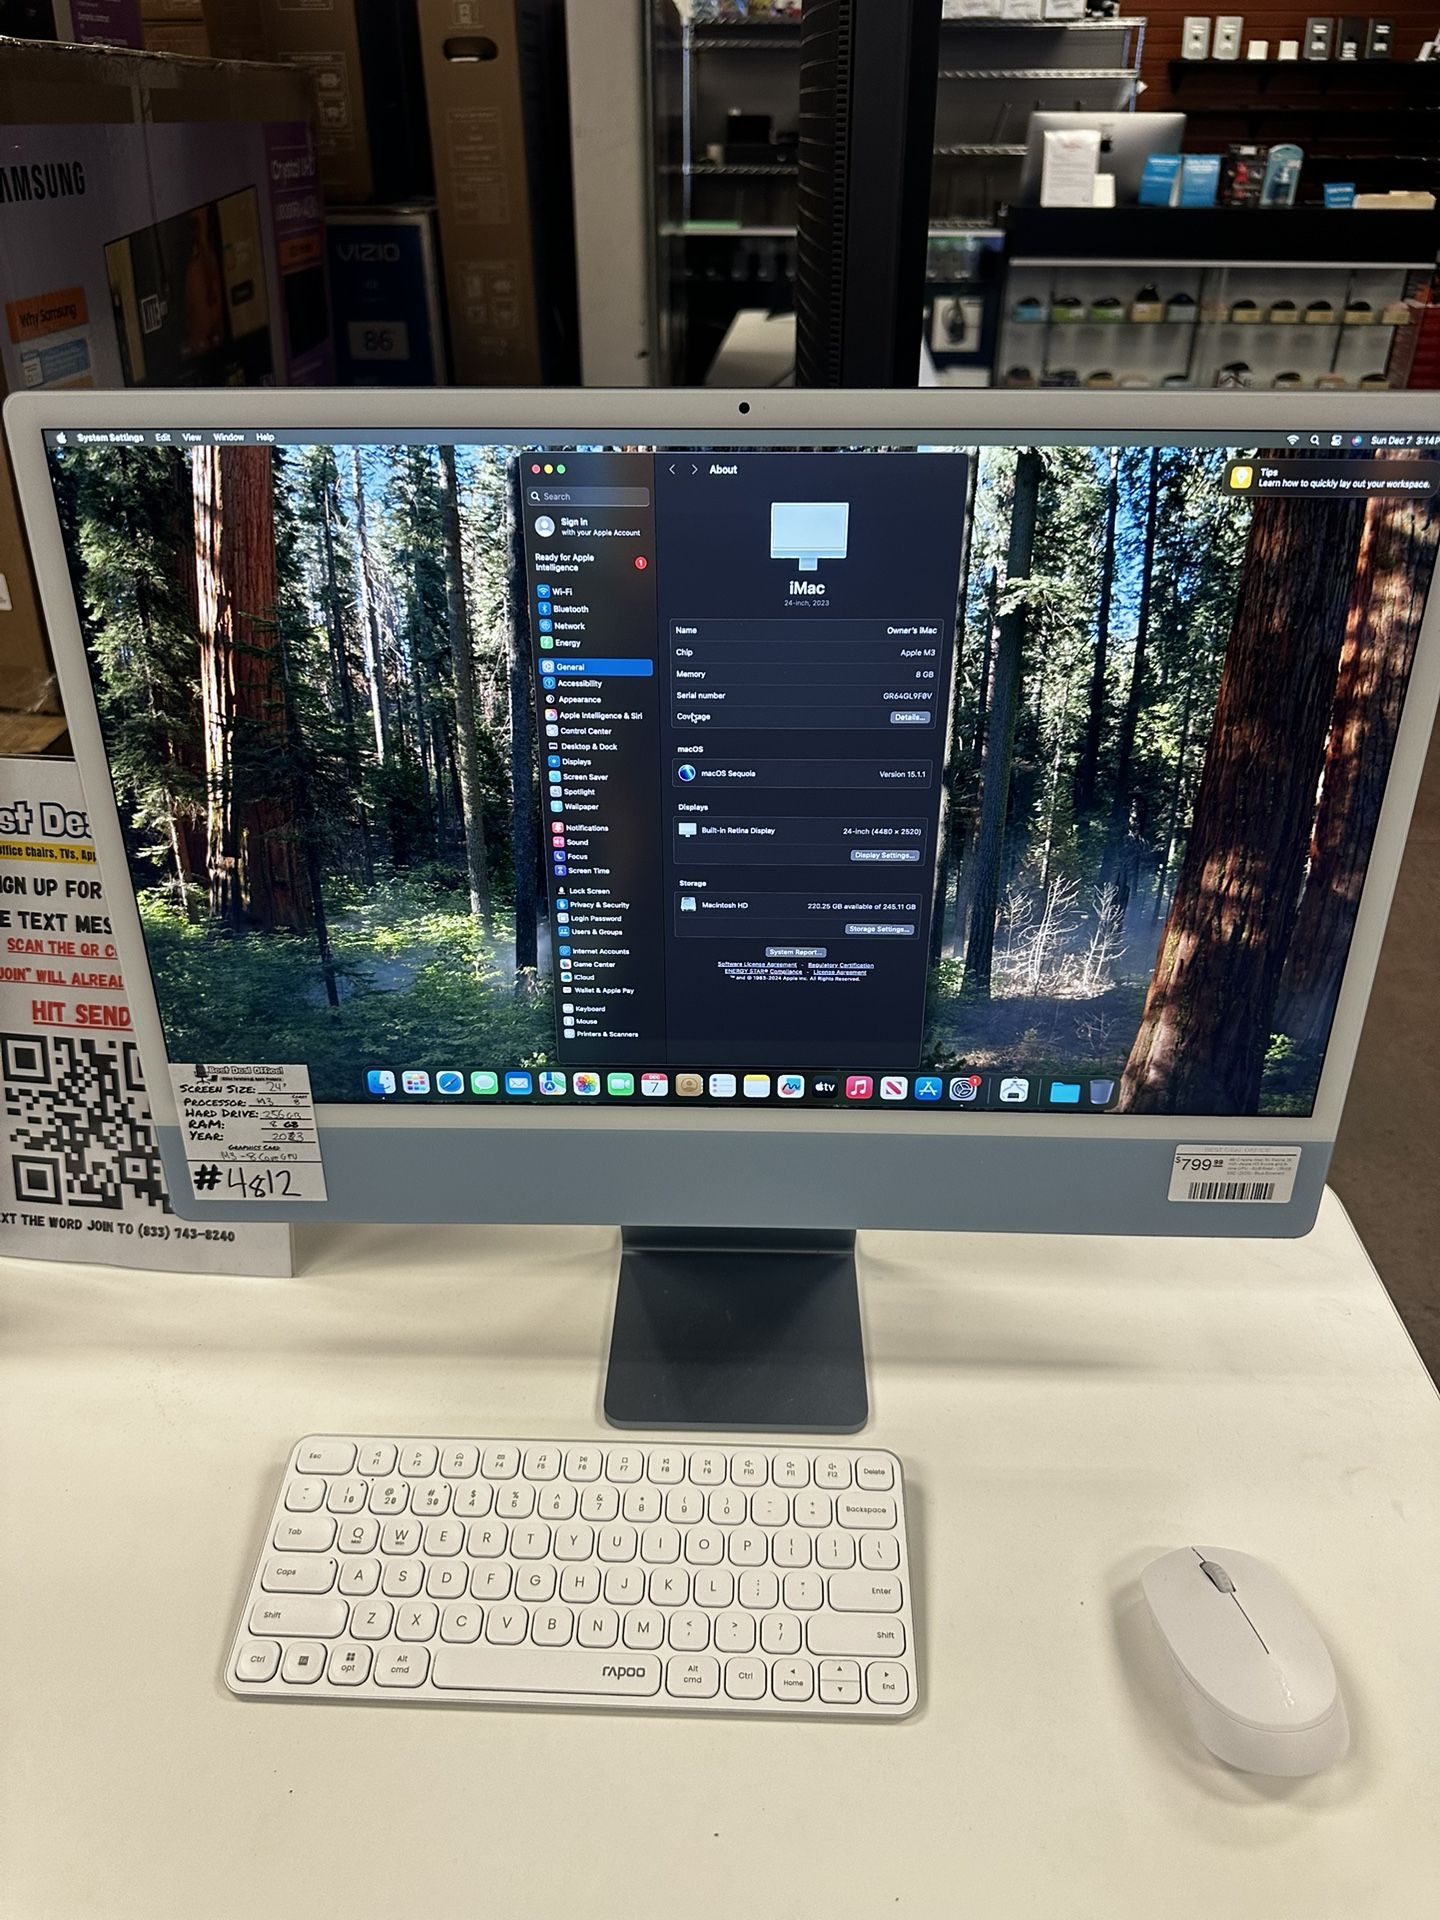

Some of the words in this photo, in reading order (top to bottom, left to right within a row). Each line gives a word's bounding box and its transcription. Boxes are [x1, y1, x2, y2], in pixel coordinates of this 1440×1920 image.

[337, 243, 400, 262] VIZIO
[19, 312, 39, 328] Why
[40, 303, 77, 322] Samsung
[364, 331, 394, 352] 86
[77, 433, 108, 443] System
[109, 433, 144, 443] Settings
[155, 433, 171, 442] Edit
[182, 433, 201, 441] View
[213, 433, 244, 441] Window
[256, 433, 275, 442] Help
[1371, 436, 1387, 445] Sun
[1388, 436, 1405, 445] Dec
[1406, 436, 1413, 444] 7
[709, 464, 737, 474] About
[1261, 468, 1278, 478] Tips
[1259, 479, 1281, 487] Learn
[1282, 479, 1299, 487] how
[1310, 479, 1338, 489] quickly
[1367, 481, 1385, 489] your
[1386, 479, 1430, 489] workspace.
[544, 492, 570, 501] Search
[561, 517, 579, 527] Sign
[593, 529, 612, 537] Apple
[535, 553, 559, 562] Ready
[572, 554, 594, 563] Apple
[536, 563, 578, 573] Intelligence
[552, 588, 572, 596] Wi-Fi
[790, 581, 825, 595] iMac
[553, 605, 589, 613] Bluetooth
[554, 622, 585, 630] Network
[676, 626, 697, 634] Name
[555, 639, 581, 648] Energy
[676, 648, 693, 657] Chip
[900, 649, 922, 657] Apple
[557, 663, 584, 671] General
[676, 670, 706, 679] Memory
[558, 680, 602, 688] Accessibility
[559, 696, 601, 704] Appearance
[677, 713, 711, 722] Covage
[562, 758, 591, 766] Displays
[728, 770, 756, 778] Sequoia
[678, 804, 708, 812] Displays
[750, 827, 775, 835] Display
[871, 828, 893, 836] (4480
[25, 846, 57, 859] Chairs,
[59, 848, 79, 860] TVs,
[33, 878, 58, 896] UP
[65, 880, 102, 899] FOR
[679, 880, 707, 888] Storage
[17, 911, 68, 931] TEXT
[7, 938, 44, 952] SCAN
[48, 940, 75, 954] THE
[80, 943, 100, 956] QR
[36, 969, 67, 984] WILL
[32, 1000, 66, 1021] HIT
[76, 1003, 131, 1026] SEND
[188, 1120, 225, 1129] RAM:
[21, 1213, 45, 1227] THE
[49, 1217, 82, 1230] WORD
[87, 1220, 114, 1233] JOIN
[117, 1222, 133, 1235] TO
[138, 1223, 170, 1240] (833)
[174, 1227, 236, 1242] 743-8240
[846, 1506, 887, 1514] Backspace
[276, 1568, 296, 1576] Caps
[872, 1587, 891, 1595] Enter
[264, 1611, 281, 1619] Shift
[341, 1664, 355, 1673] opt
